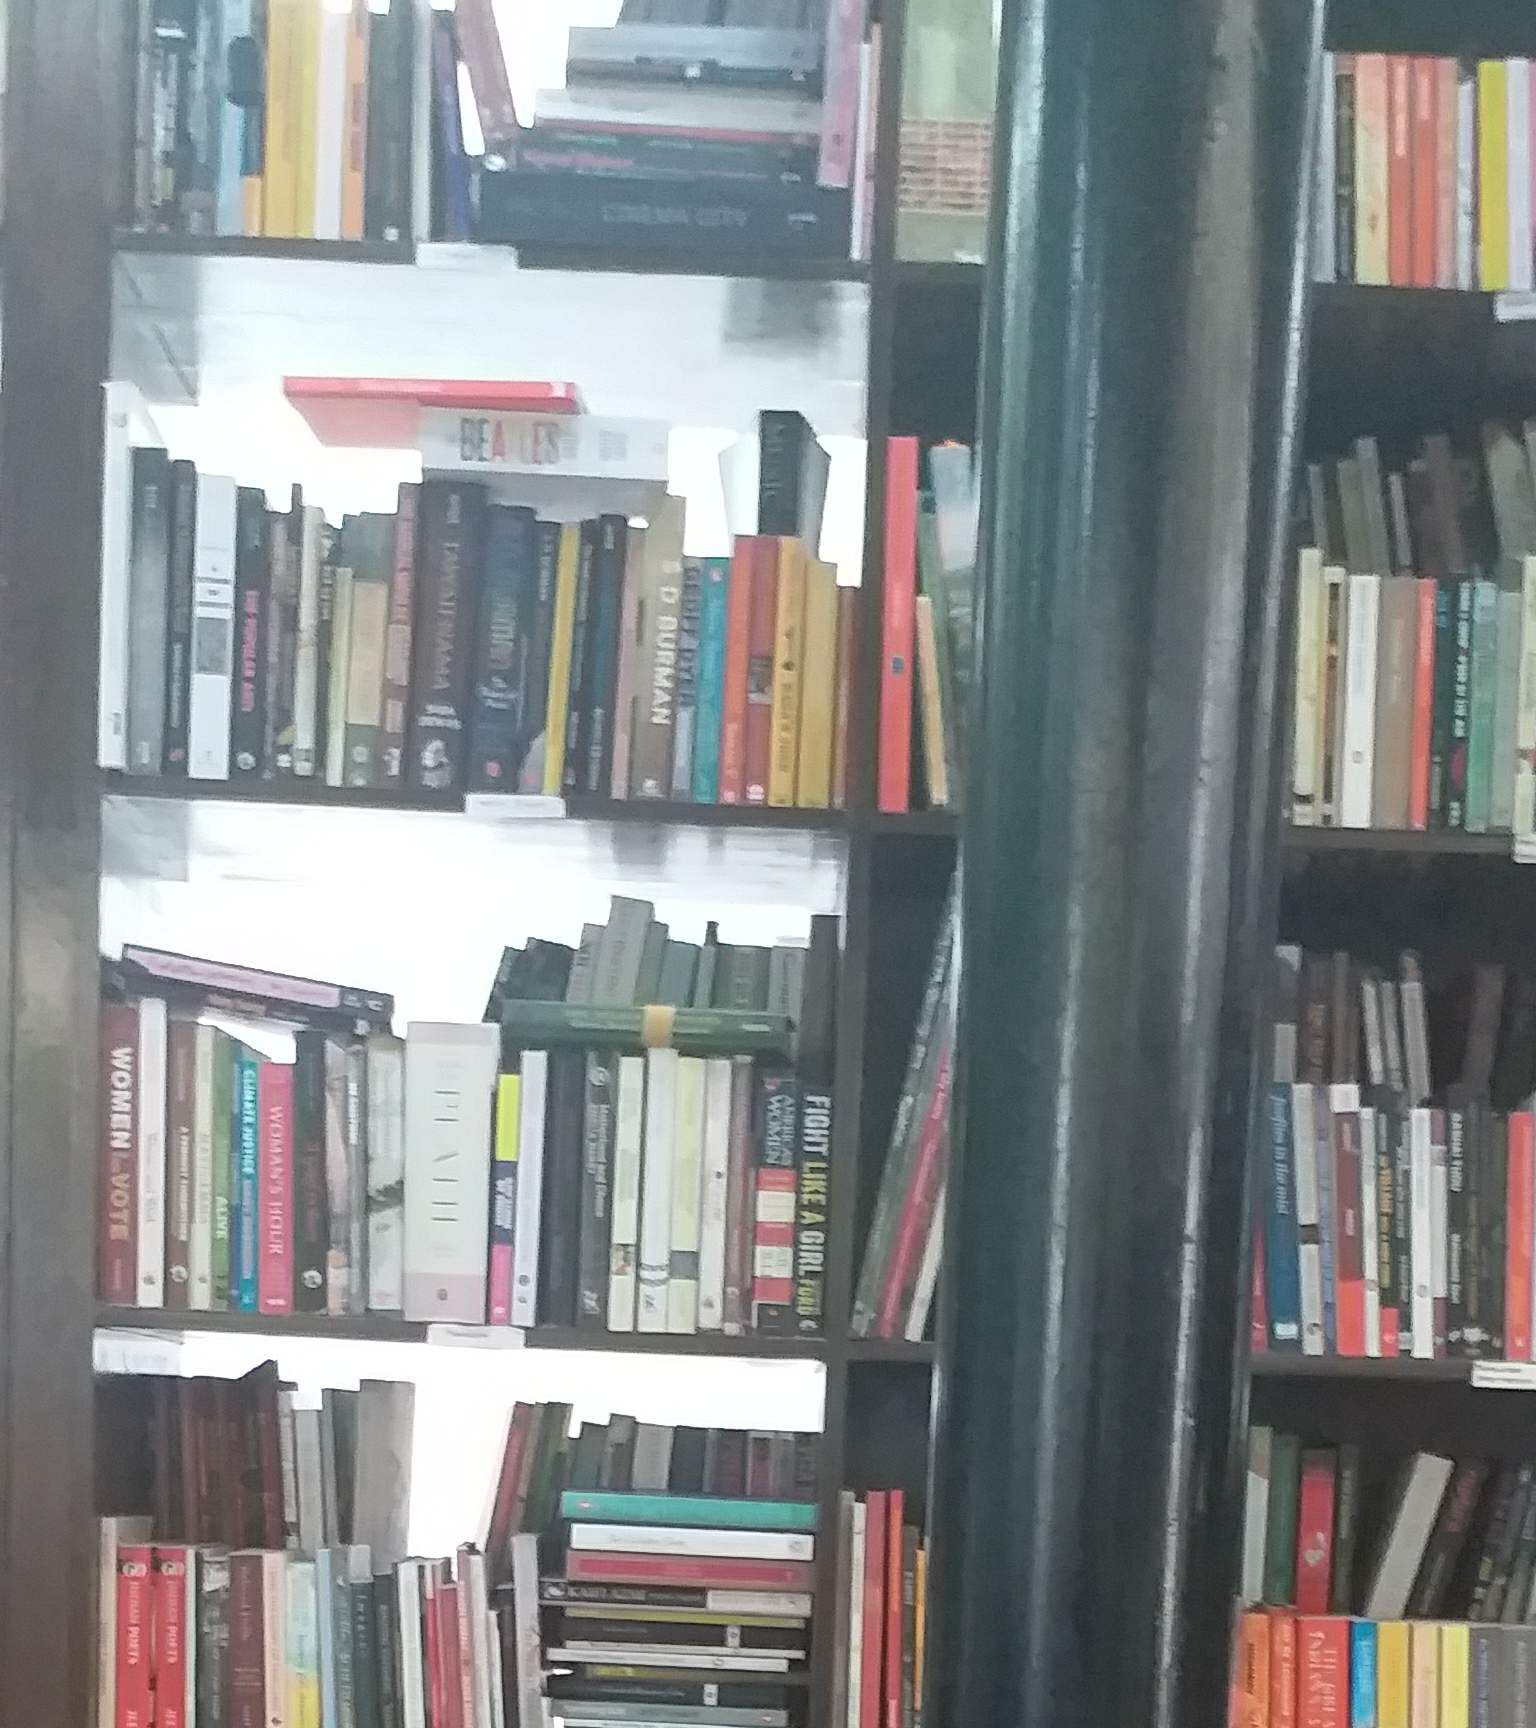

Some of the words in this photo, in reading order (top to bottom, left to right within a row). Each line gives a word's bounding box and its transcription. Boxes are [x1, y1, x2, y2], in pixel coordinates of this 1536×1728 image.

[649, 616, 673, 726] BURMAN
[109, 1047, 133, 1150] WOMEN
[242, 1068, 258, 1125] CLIMATE
[267, 1105, 286, 1196] WOMAN'S
[765, 1094, 783, 1166] WOMEN
[804, 1095, 831, 1156] FIGHT
[109, 1171, 130, 1241] VOTE
[803, 1161, 828, 1206] LIKE
[215, 1196, 229, 1240] ALIVE
[268, 1201, 286, 1256] HOUR
[801, 1210, 825, 1226] A
[799, 1230, 825, 1277] GIRL
[128, 1626, 142, 1665] POETS
[166, 1625, 181, 1664] POETS
